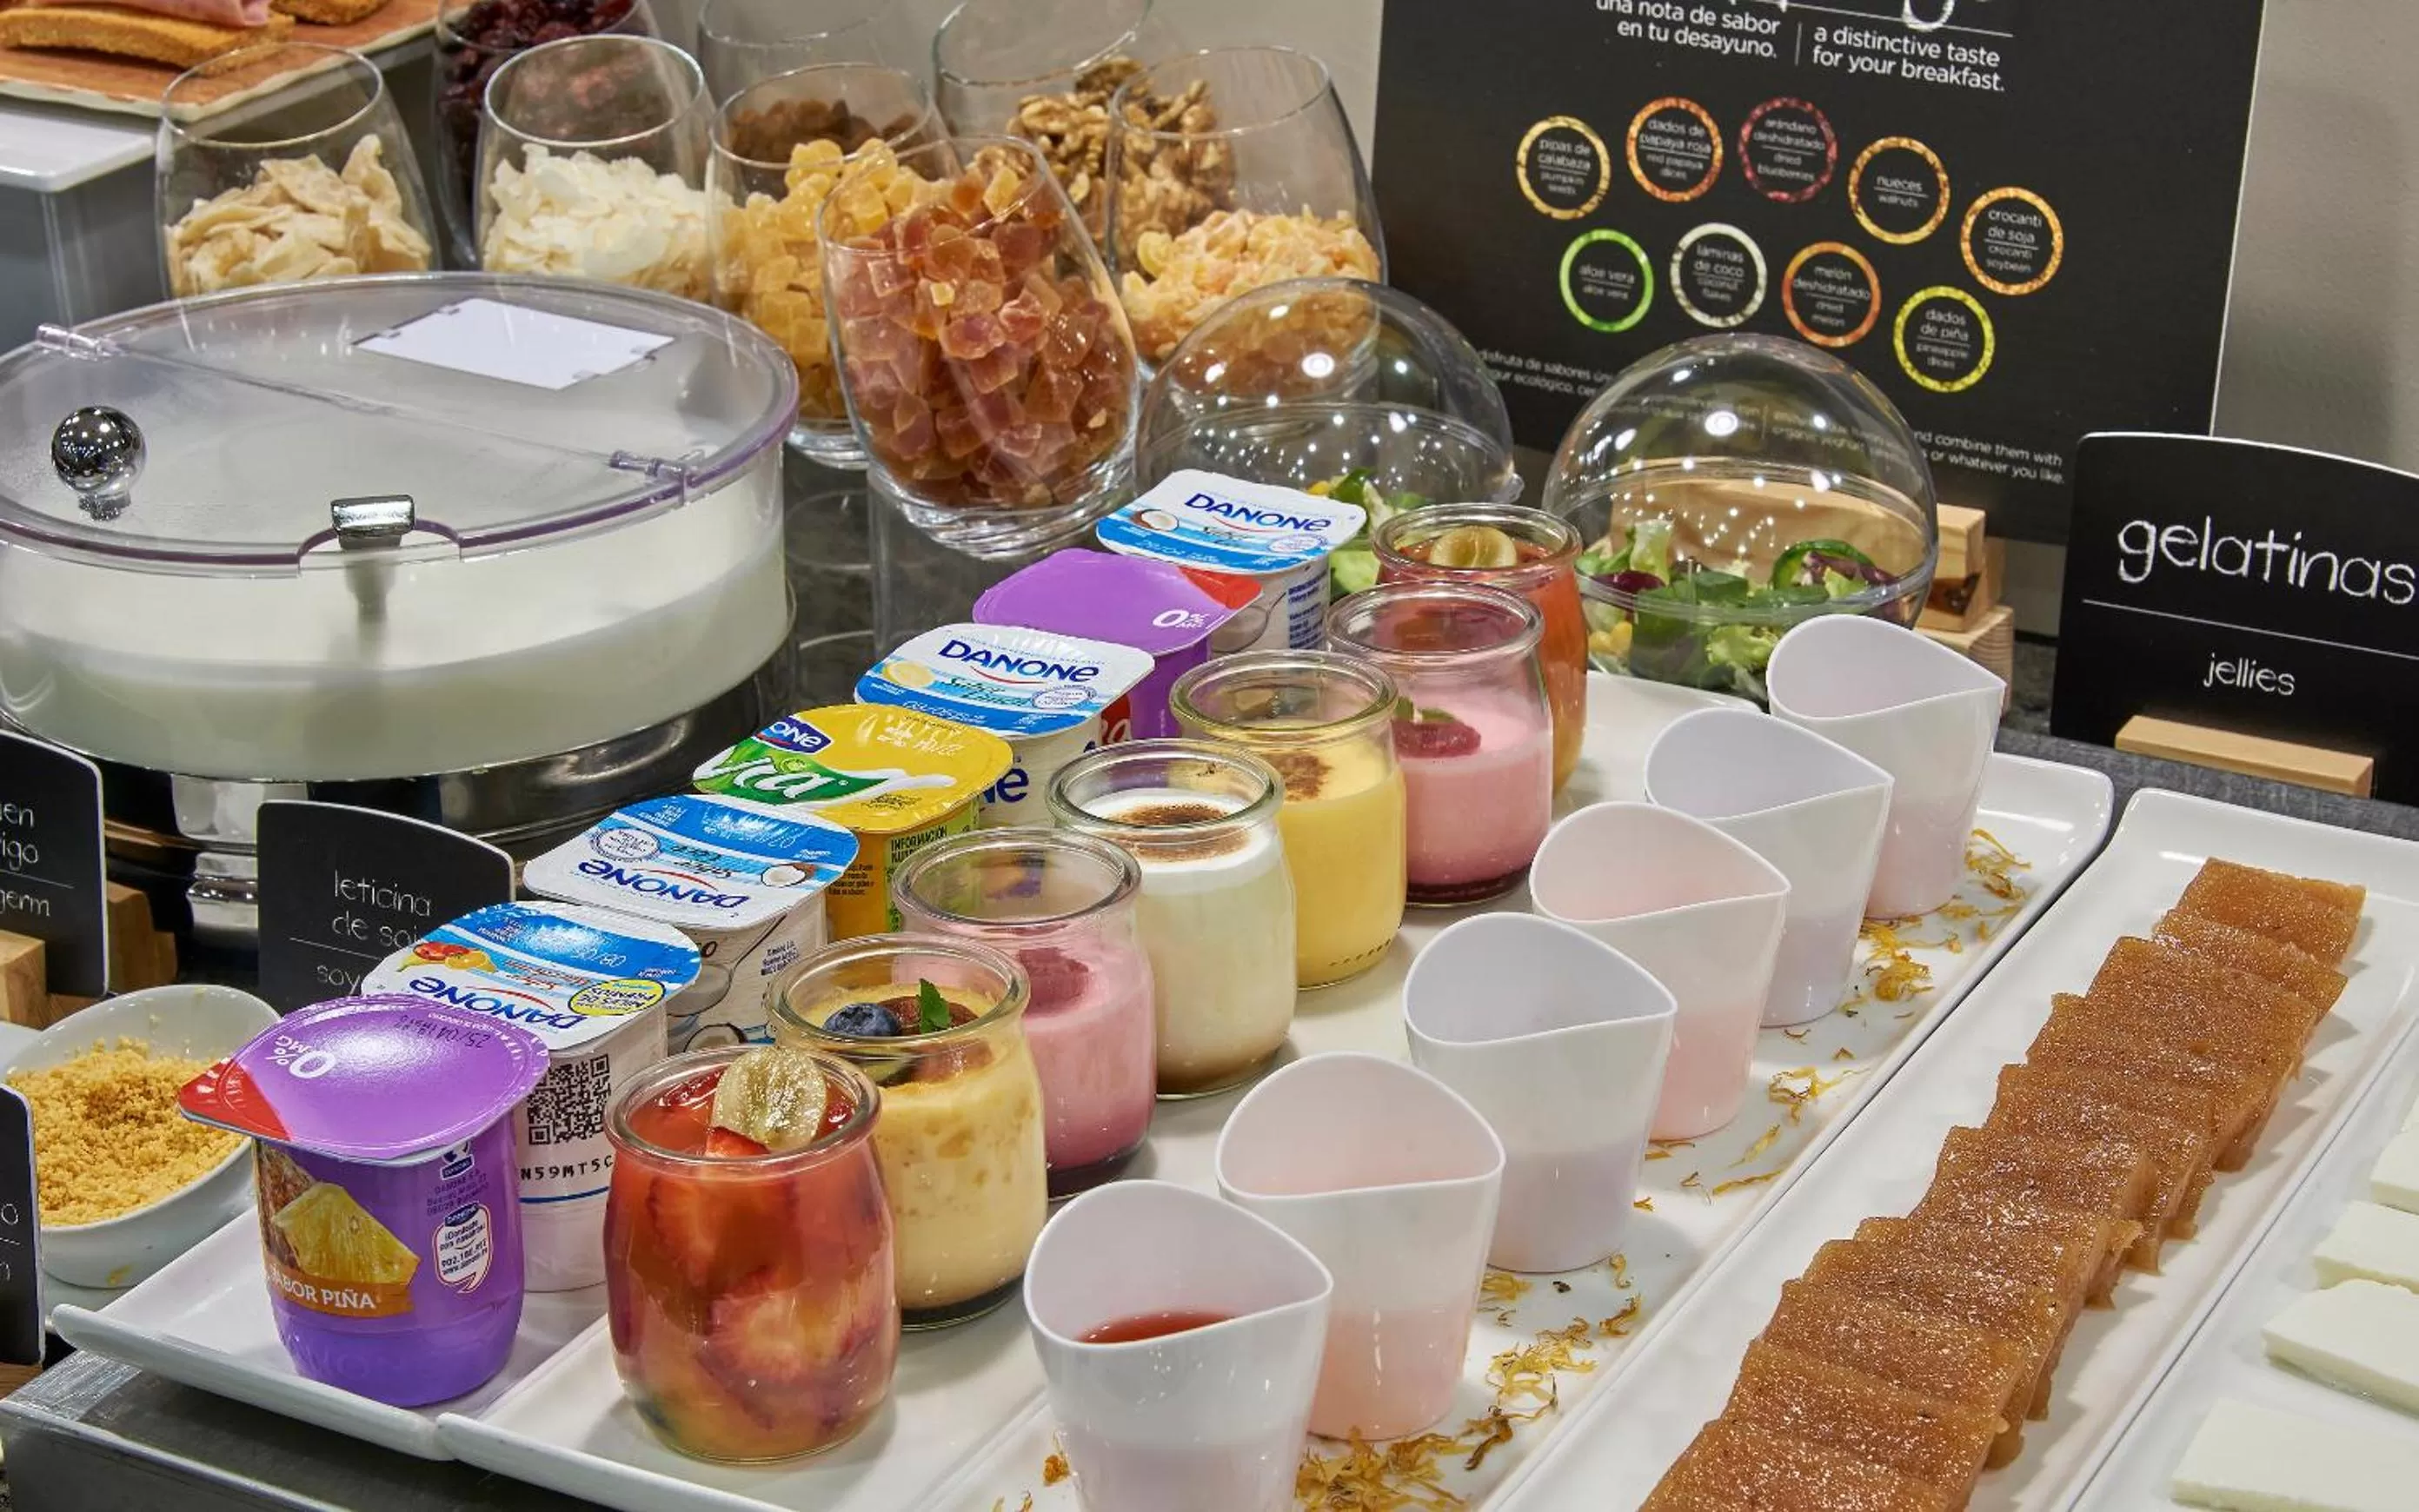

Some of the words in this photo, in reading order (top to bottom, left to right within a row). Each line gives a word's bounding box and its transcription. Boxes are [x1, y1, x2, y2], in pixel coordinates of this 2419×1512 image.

[1596, 0, 1632, 14] una
[1638, 2, 1685, 22] nota
[1689, 5, 1717, 26] de
[1721, 11, 1781, 35] sabor
[1617, 20, 1643, 37] en
[1647, 22, 1670, 42] tu
[1673, 25, 1778, 59] desayuno.
[1813, 26, 1827, 43] a
[1832, 26, 1942, 59] distinctive
[1946, 42, 2001, 68] taste
[1812, 45, 1843, 67] for
[1847, 54, 1897, 75] your
[1900, 57, 2006, 92] breakfast.
[1647, 118, 1685, 135] dados
[1688, 123, 1705, 137] de
[1538, 139, 1572, 154] pipas
[1574, 143, 1592, 156] de
[1639, 133, 1685, 151] papaya
[1537, 154, 1591, 171] calabaza
[1876, 175, 1923, 192] nueces
[1877, 194, 1919, 208] walnuts
[1988, 208, 2042, 228] crocanti
[1987, 225, 2006, 241] de
[2007, 229, 2036, 245] soja
[1578, 263, 1605, 277] aloe
[1609, 271, 1635, 285] vera
[1693, 260, 1711, 273] de
[1713, 263, 1744, 277] coco
[1814, 265, 1852, 282] melón
[1793, 276, 1871, 302] deshidratado
[1925, 308, 1966, 327] dados
[1919, 322, 1937, 336] de
[1940, 326, 1969, 342] piña
[1525, 357, 1541, 371] de
[1544, 361, 1592, 381] sabores
[1913, 430, 1932, 443] nd
[1935, 434, 1991, 454] combine
[1995, 443, 2030, 460] them
[2033, 452, 2063, 467] with
[1930, 450, 1944, 461] or
[1948, 453, 2010, 474] whatever
[2011, 466, 2037, 480] you
[2117, 515, 2416, 605] gelatinas
[2203, 653, 2296, 696] jellies
[0, 832, 39, 872] igo
[334, 868, 431, 917] leticina
[332, 911, 369, 942] de
[320, 1288, 377, 1310] PIÑA
